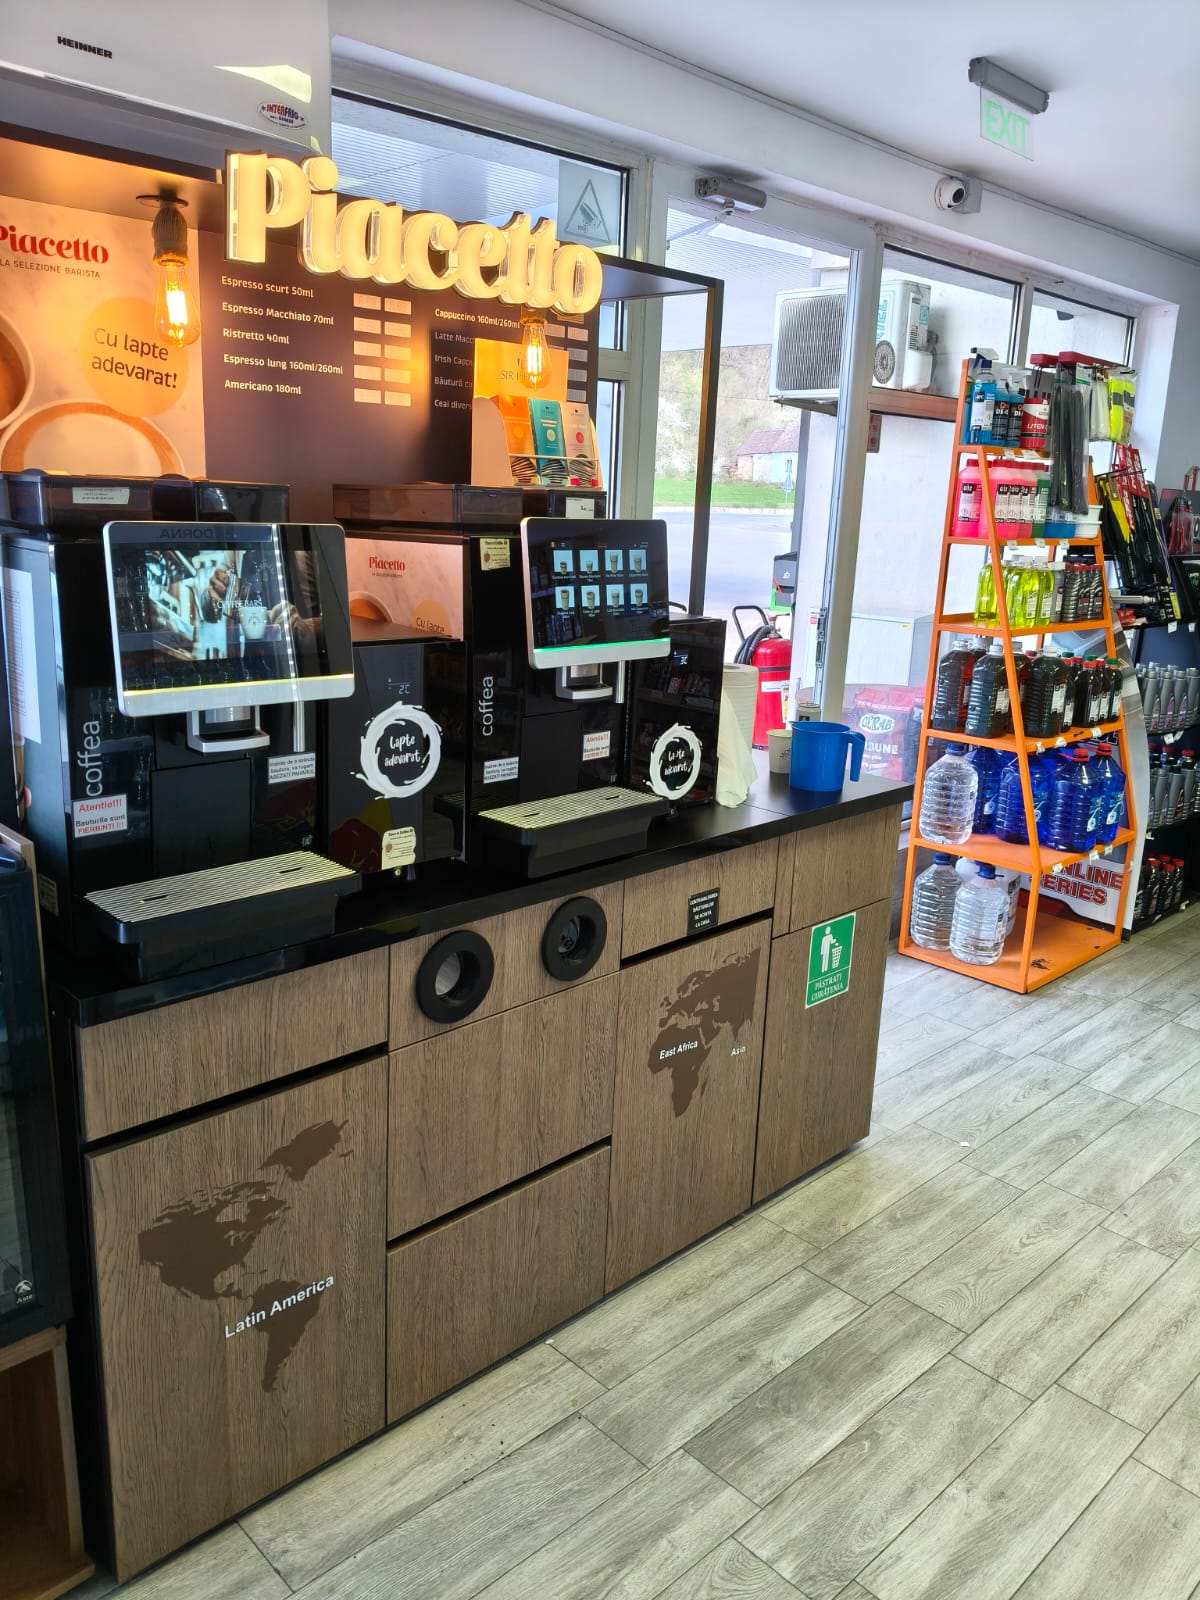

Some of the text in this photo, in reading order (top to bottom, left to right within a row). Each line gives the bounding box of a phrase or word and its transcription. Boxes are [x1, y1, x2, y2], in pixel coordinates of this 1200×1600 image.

[57, 35, 113, 59] HEINNER
[985, 100, 1030, 152] EXIT
[225, 150, 604, 315] Piacetto
[13, 260, 62, 274] SELEZIONE
[65, 267, 101, 279] BARISTA
[221, 275, 314, 298] Espresso scurt 50ml
[222, 302, 334, 326] Espresso Macchiato 70ml
[434, 308, 521, 329] Cappuccino 160ml/260ml
[94, 328, 169, 362] Cu lapte
[223, 328, 290, 345] Ristretto 40ml
[434, 331, 454, 342] Latte
[223, 354, 344, 375] Espresso lung 160ml/260ml
[434, 354, 452, 364] Irish
[91, 356, 178, 389] adevarat!
[224, 380, 302, 395] Americano 180ml
[434, 399, 450, 408] Ceai
[368, 556, 406, 571] Piacetto
[479, 676, 494, 736] coffea
[76, 720, 103, 797] coffea
[75, 816, 109, 828] Bauturile
[659, 1040, 699, 1061] East Africa
[731, 1045, 747, 1057] Asia
[224, 1274, 335, 1339] Latin America
